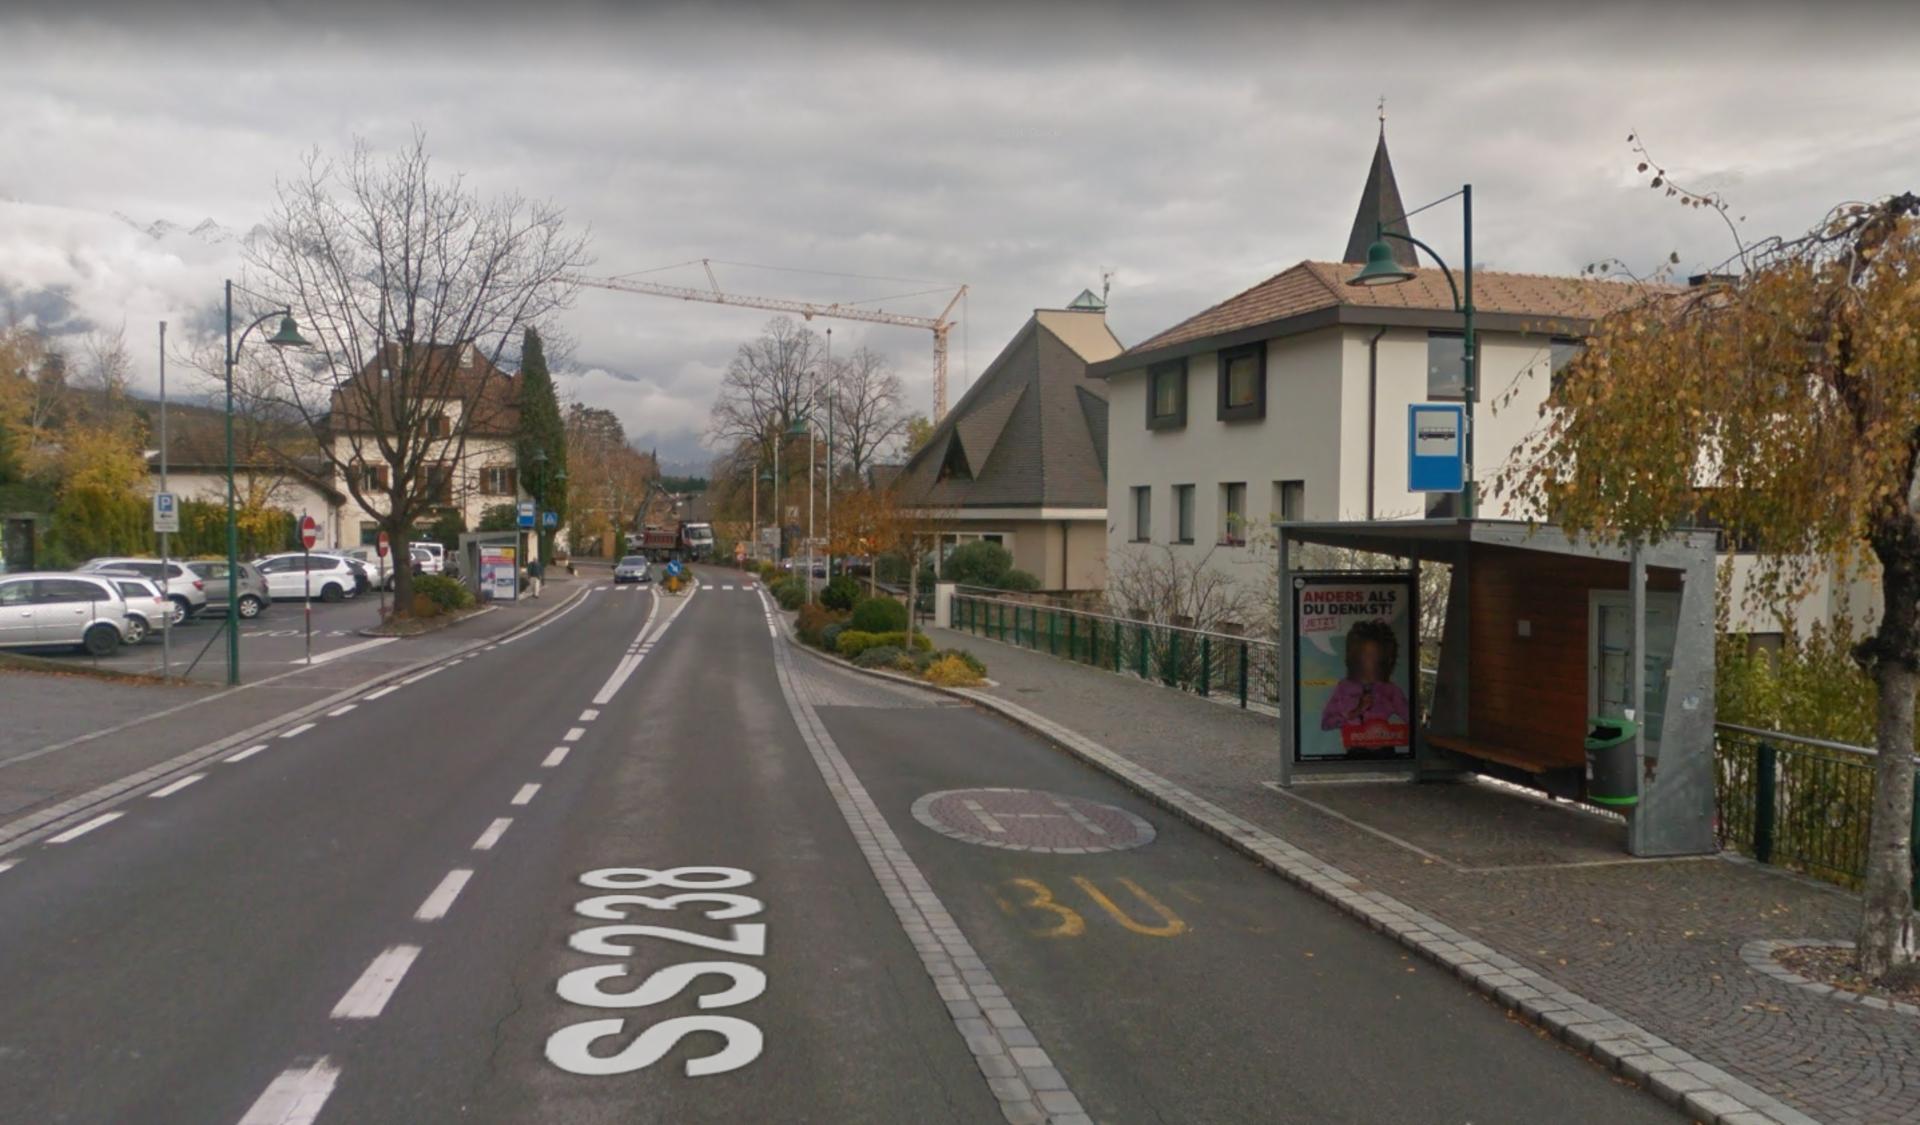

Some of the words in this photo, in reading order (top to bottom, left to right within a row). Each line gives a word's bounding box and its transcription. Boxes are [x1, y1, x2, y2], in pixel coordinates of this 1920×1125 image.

[1304, 591, 1364, 602] ANDERS
[1368, 591, 1396, 602] ALS
[1304, 604, 1325, 615] DU
[1328, 603, 1393, 615] DENKST!
[544, 867, 766, 1077] SS238
